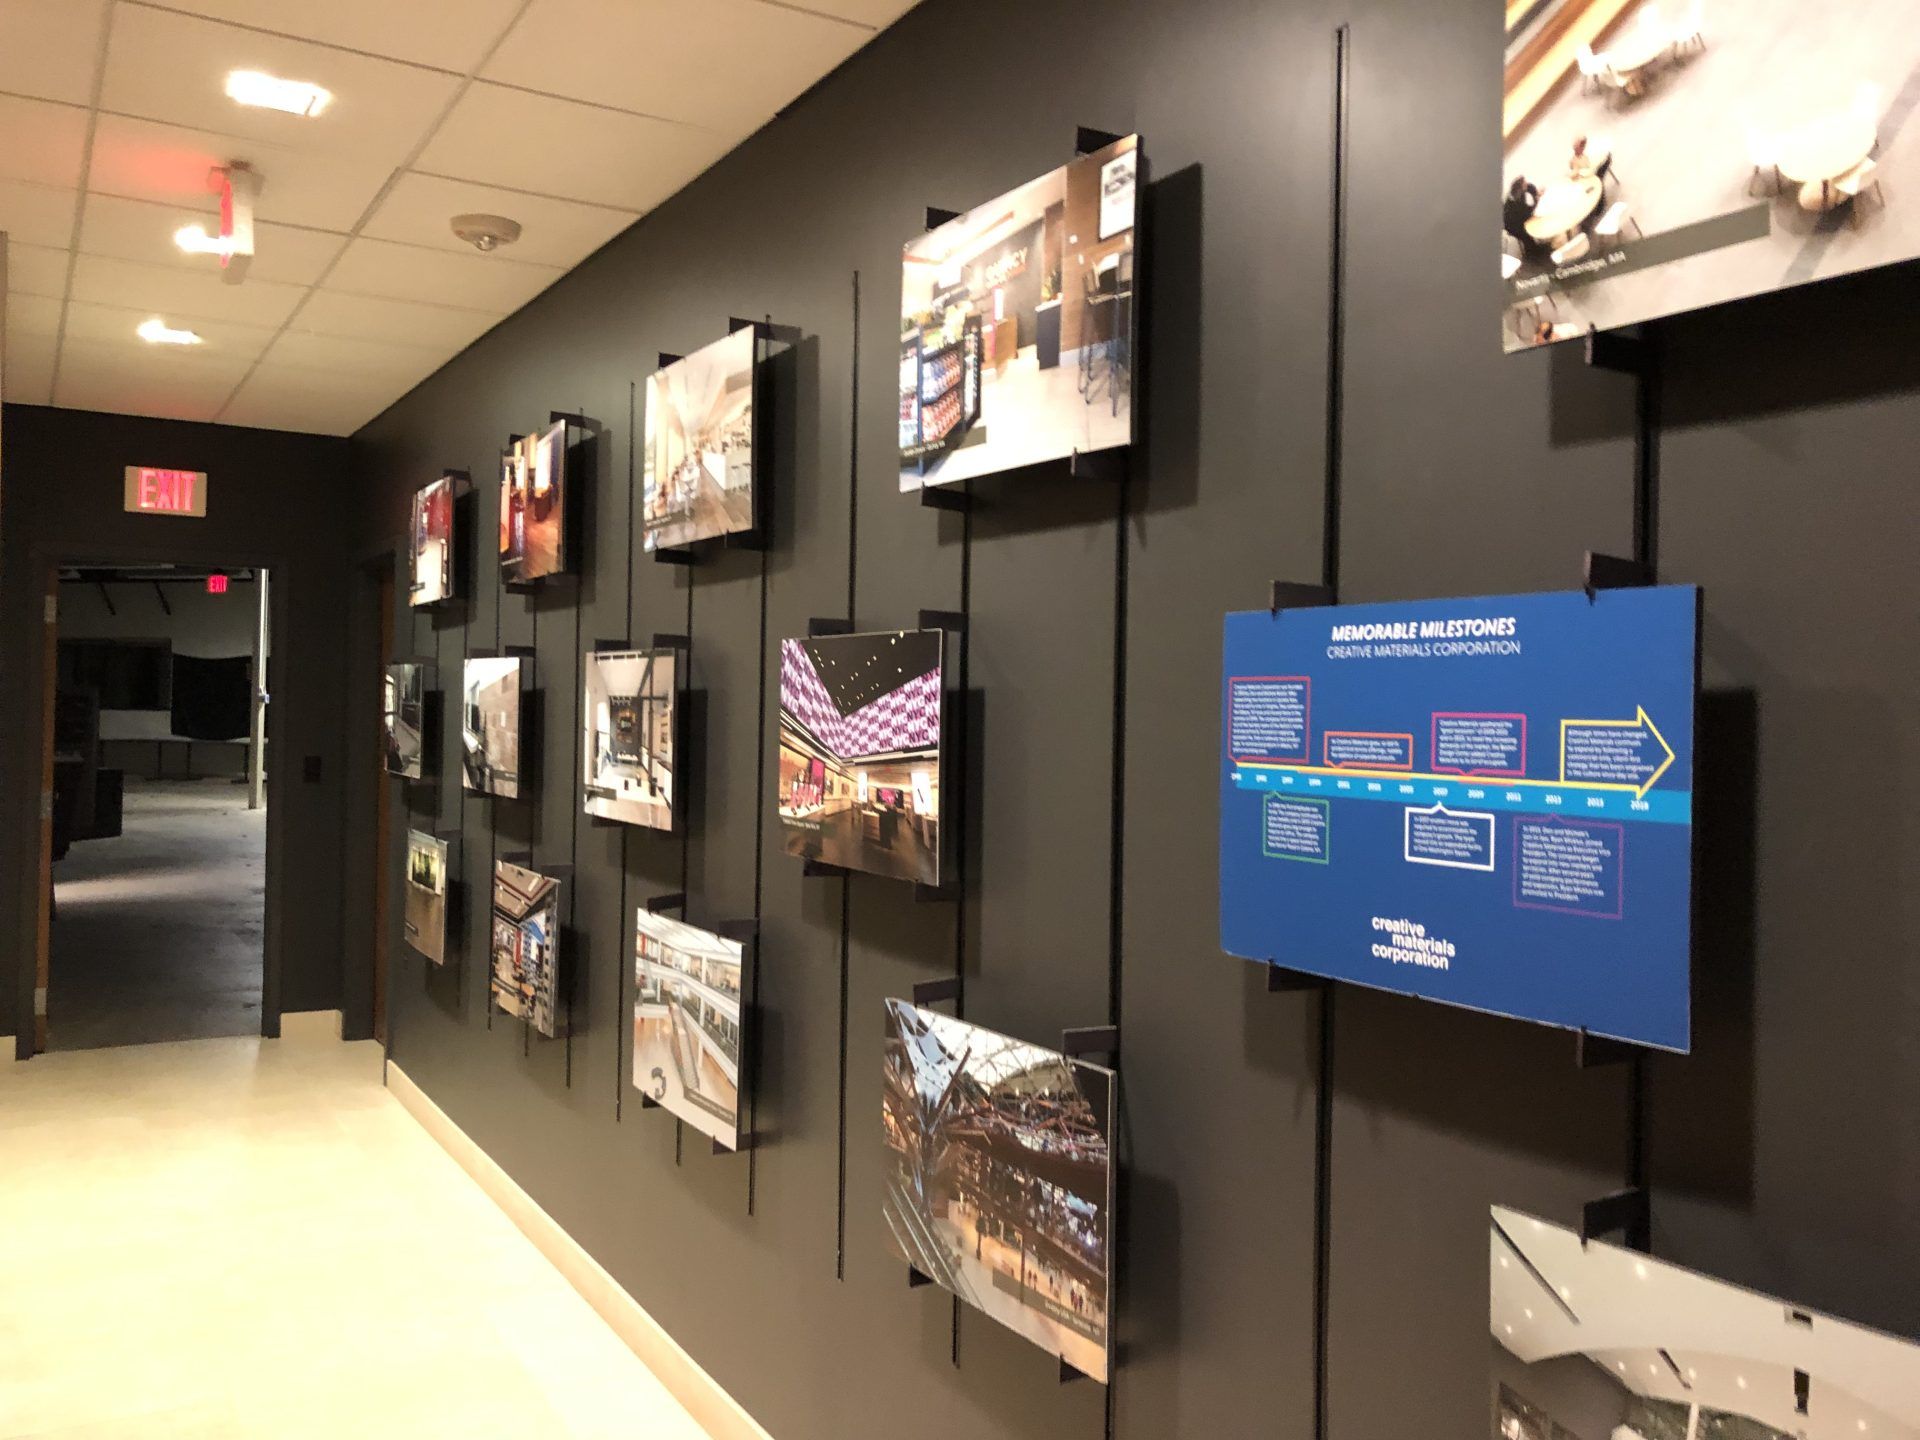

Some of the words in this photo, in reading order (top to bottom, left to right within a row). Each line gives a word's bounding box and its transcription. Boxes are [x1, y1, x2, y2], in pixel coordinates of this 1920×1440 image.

[139, 468, 197, 511] EXIT
[209, 575, 228, 593] EXIT
[1331, 621, 1417, 642] MEMORABLE
[1420, 617, 1516, 638] MILESTONES
[1327, 642, 1372, 659] CREATIVE
[1374, 641, 1431, 658] MATERIALS
[1432, 639, 1521, 656] CORPORATION
[1372, 916, 1425, 937] creative
[1372, 942, 1449, 971] corporation
[1392, 932, 1455, 958] materials
